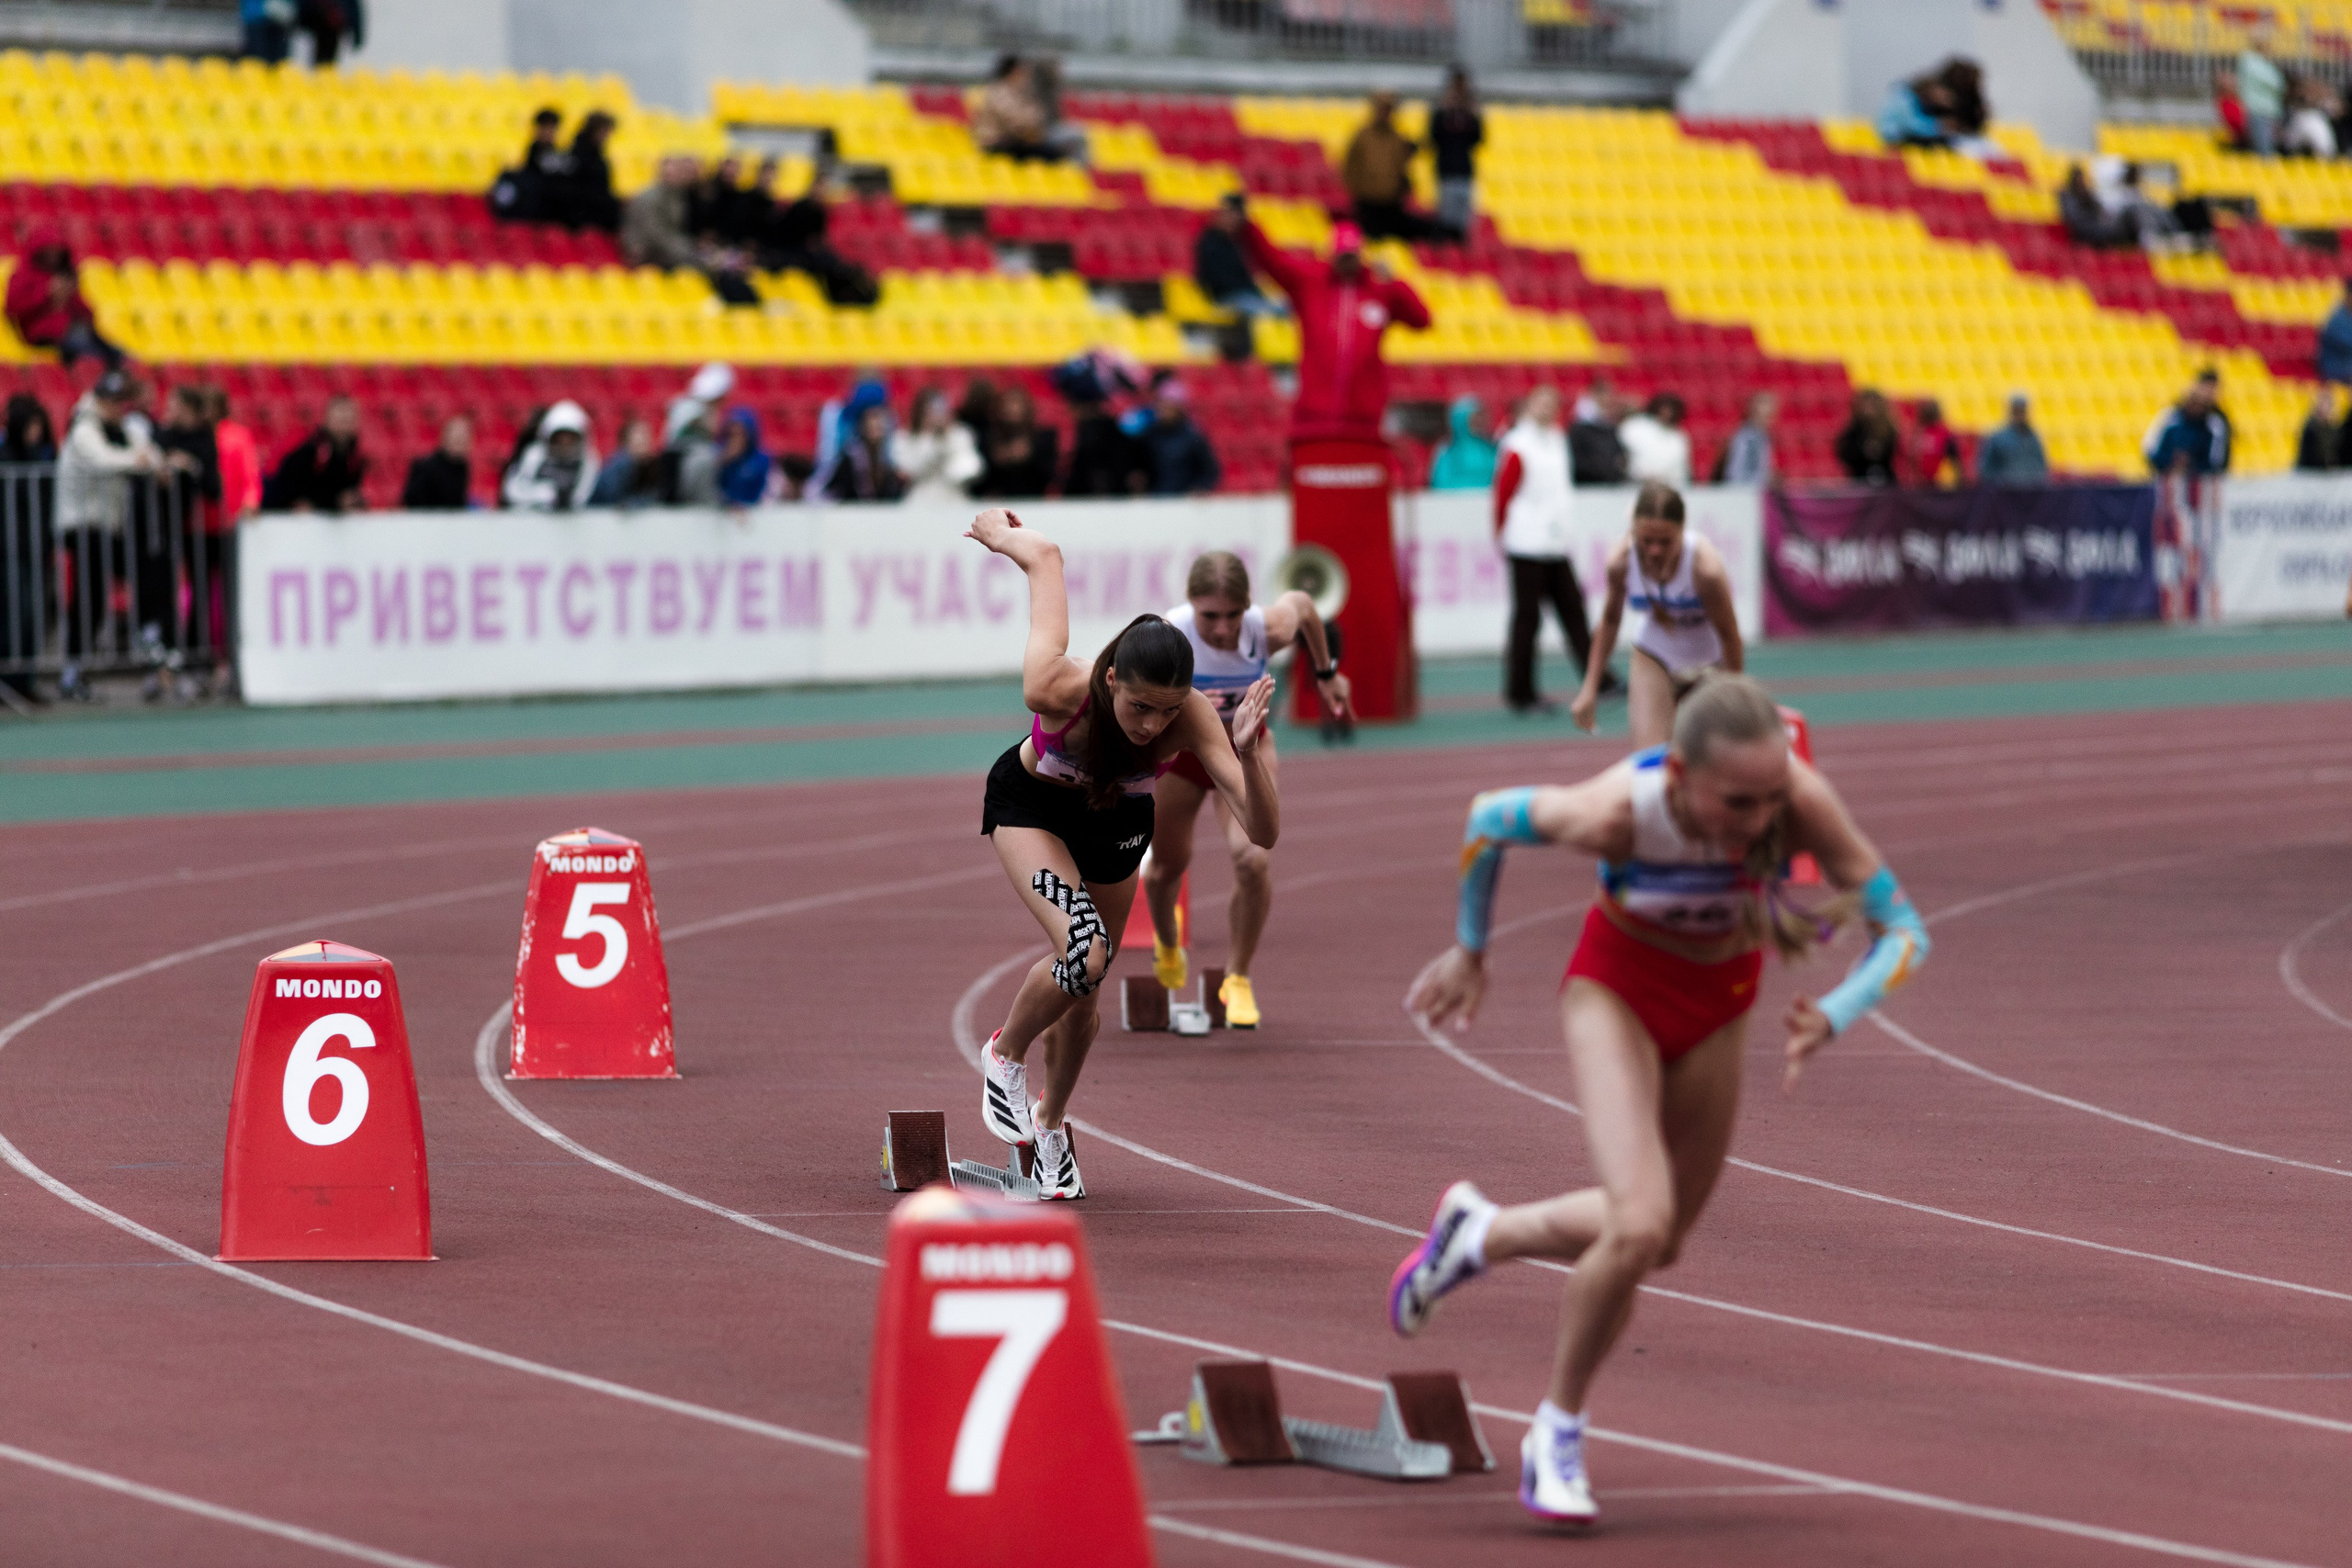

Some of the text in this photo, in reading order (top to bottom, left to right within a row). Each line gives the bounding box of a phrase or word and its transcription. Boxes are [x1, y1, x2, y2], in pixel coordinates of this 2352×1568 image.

[267, 544, 1258, 649] ПРИВЕТСТВУЕМ УЧАСНИК
[552, 855, 632, 873] MONDO
[555, 882, 631, 988] 5
[277, 978, 381, 998] MONDO
[282, 1012, 377, 1146] 6
[922, 1244, 1073, 1280] MONDO
[931, 1289, 1068, 1495] 7
